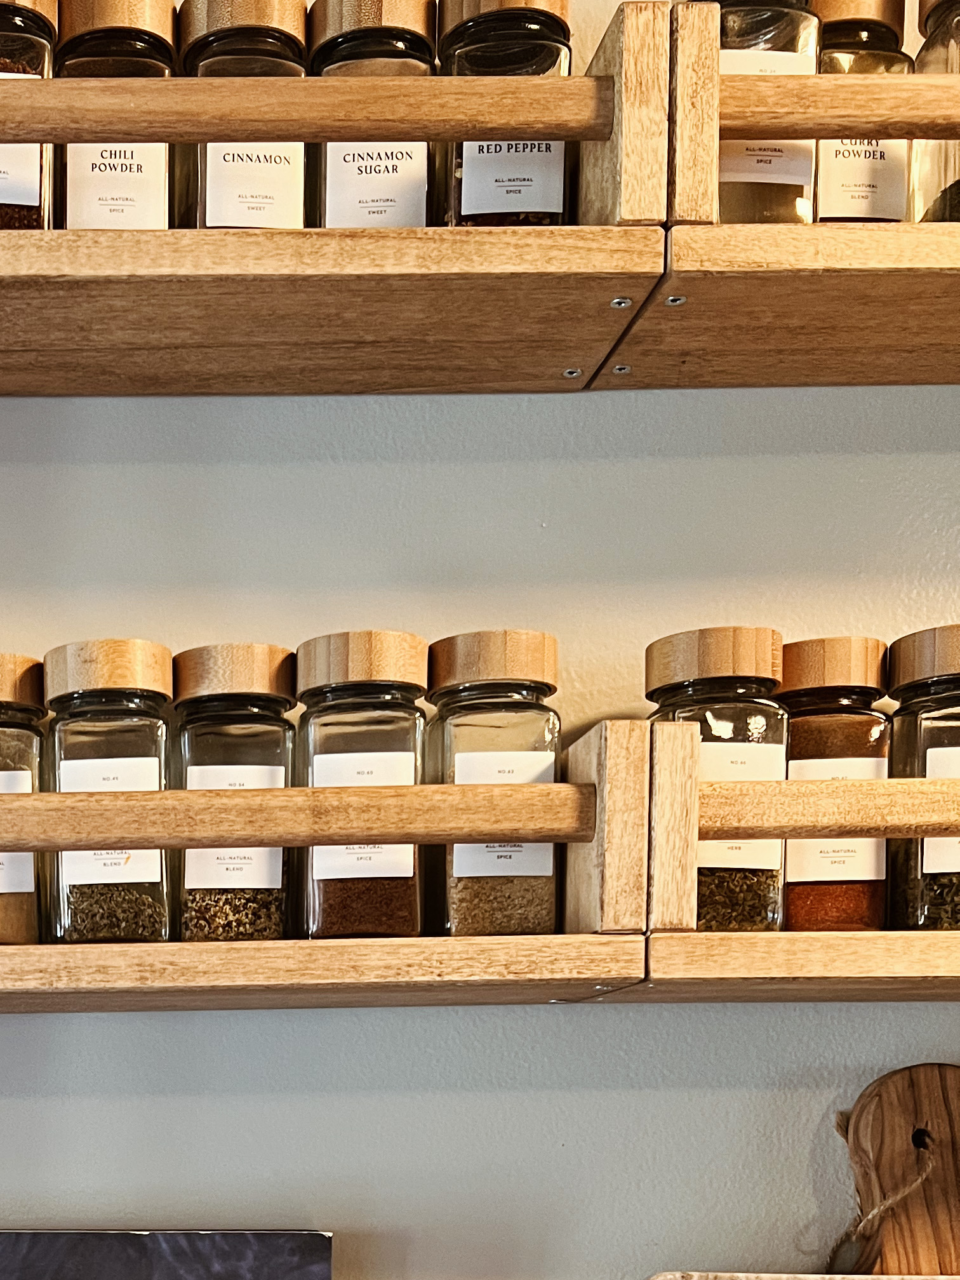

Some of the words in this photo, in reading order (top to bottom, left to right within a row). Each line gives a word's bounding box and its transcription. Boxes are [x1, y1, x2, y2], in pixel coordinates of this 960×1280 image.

[478, 144, 503, 154] RED
[507, 143, 552, 153] PEPPER
[840, 139, 879, 147] CURRY
[100, 149, 134, 160] CHILI
[222, 153, 291, 166] CINNAMON
[343, 151, 414, 163] CINNAMON
[835, 149, 886, 160] POWDER
[91, 163, 144, 173] POWDER
[357, 164, 399, 175] SUGAR
